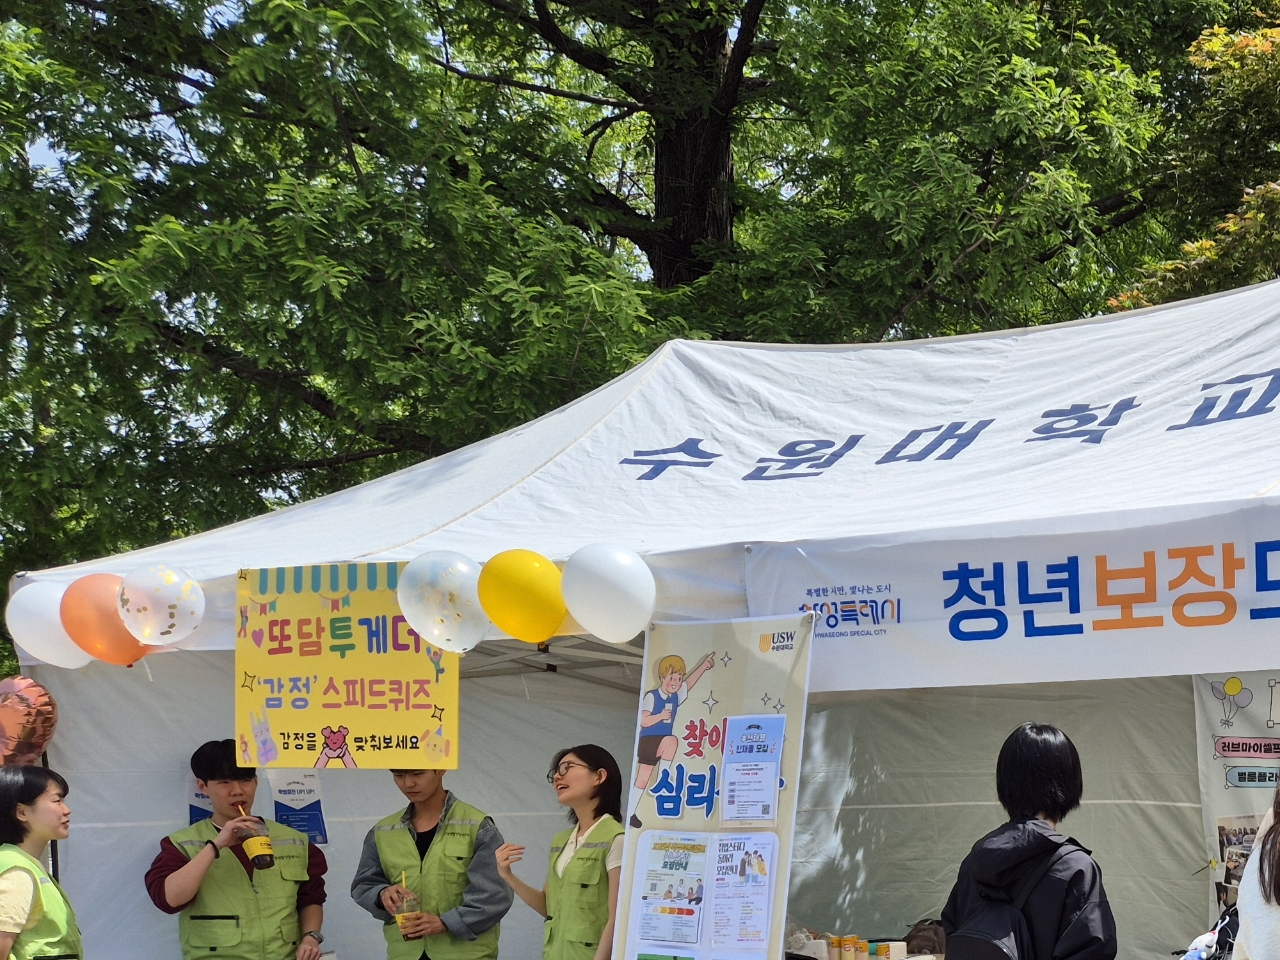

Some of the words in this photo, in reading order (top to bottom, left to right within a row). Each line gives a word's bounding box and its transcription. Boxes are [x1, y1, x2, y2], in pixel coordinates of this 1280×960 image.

[806, 586, 829, 598] 특별한
[830, 586, 847, 597] 시민,
[849, 584, 873, 595] 빛나는
[875, 583, 891, 593] 도시
[268, 614, 421, 659] 또담투게더
[772, 631, 796, 644] USW
[815, 631, 848, 639] HWASEONG
[850, 629, 873, 637] SPECIAL
[321, 676, 433, 711] 스피드퀴즈
[279, 732, 317, 751] 감정을
[353, 734, 420, 751] 맞춰보세요
[1237, 771, 1279, 783] 벌룬플라
[649, 763, 720, 819] 심리
